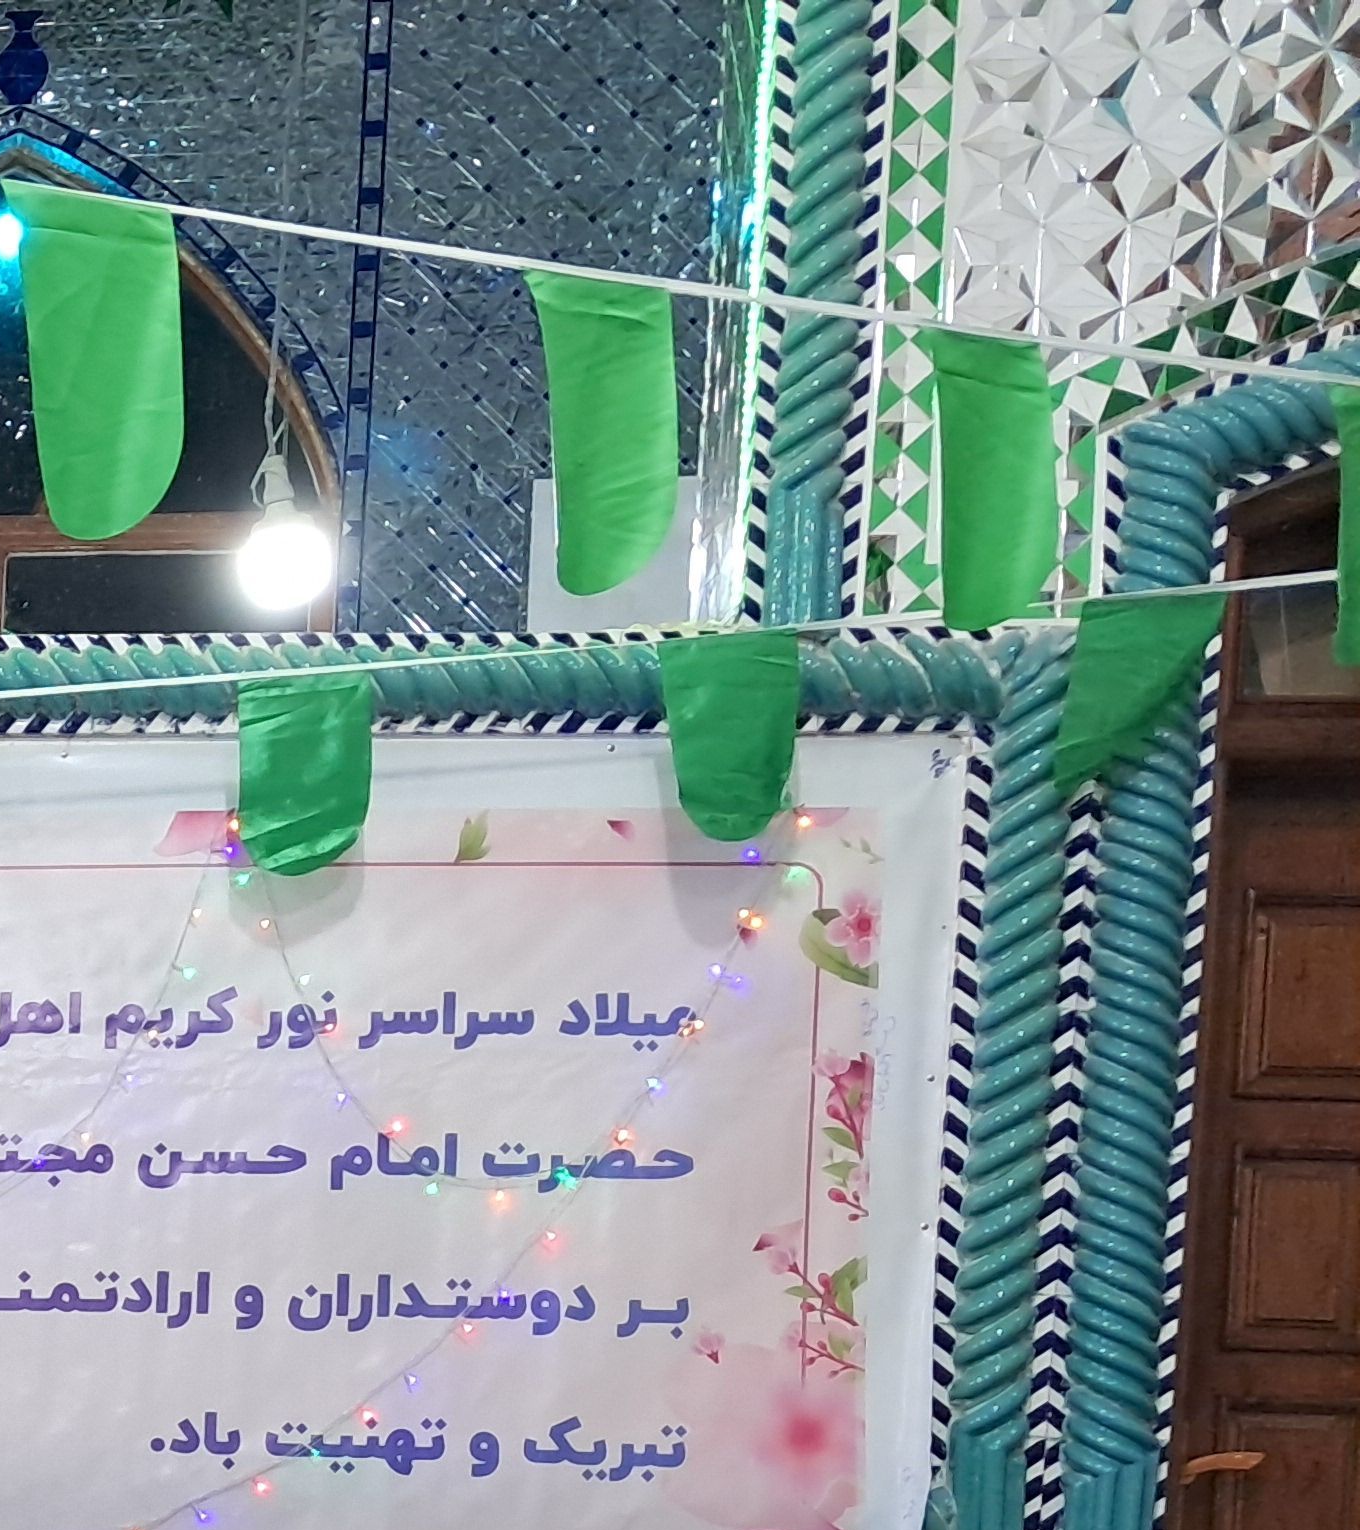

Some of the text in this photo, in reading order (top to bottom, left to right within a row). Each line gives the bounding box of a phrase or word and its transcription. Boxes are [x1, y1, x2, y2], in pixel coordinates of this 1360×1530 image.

[103, 986, 238, 1050] کریم
[258, 989, 339, 1050] نور
[358, 991, 535, 1050] سراسر
[559, 991, 696, 1052] میلاد
[137, 1138, 308, 1189] حسن
[329, 1134, 459, 1189] امام
[481, 1140, 695, 1192] حضرت
[235, 1284, 264, 1327] و
[287, 1272, 597, 1335] دوستداران
[618, 1292, 692, 1339] بر
[265, 1418, 445, 1476] تهنیت
[468, 1433, 499, 1476] و
[523, 1416, 689, 1481] تبریک
